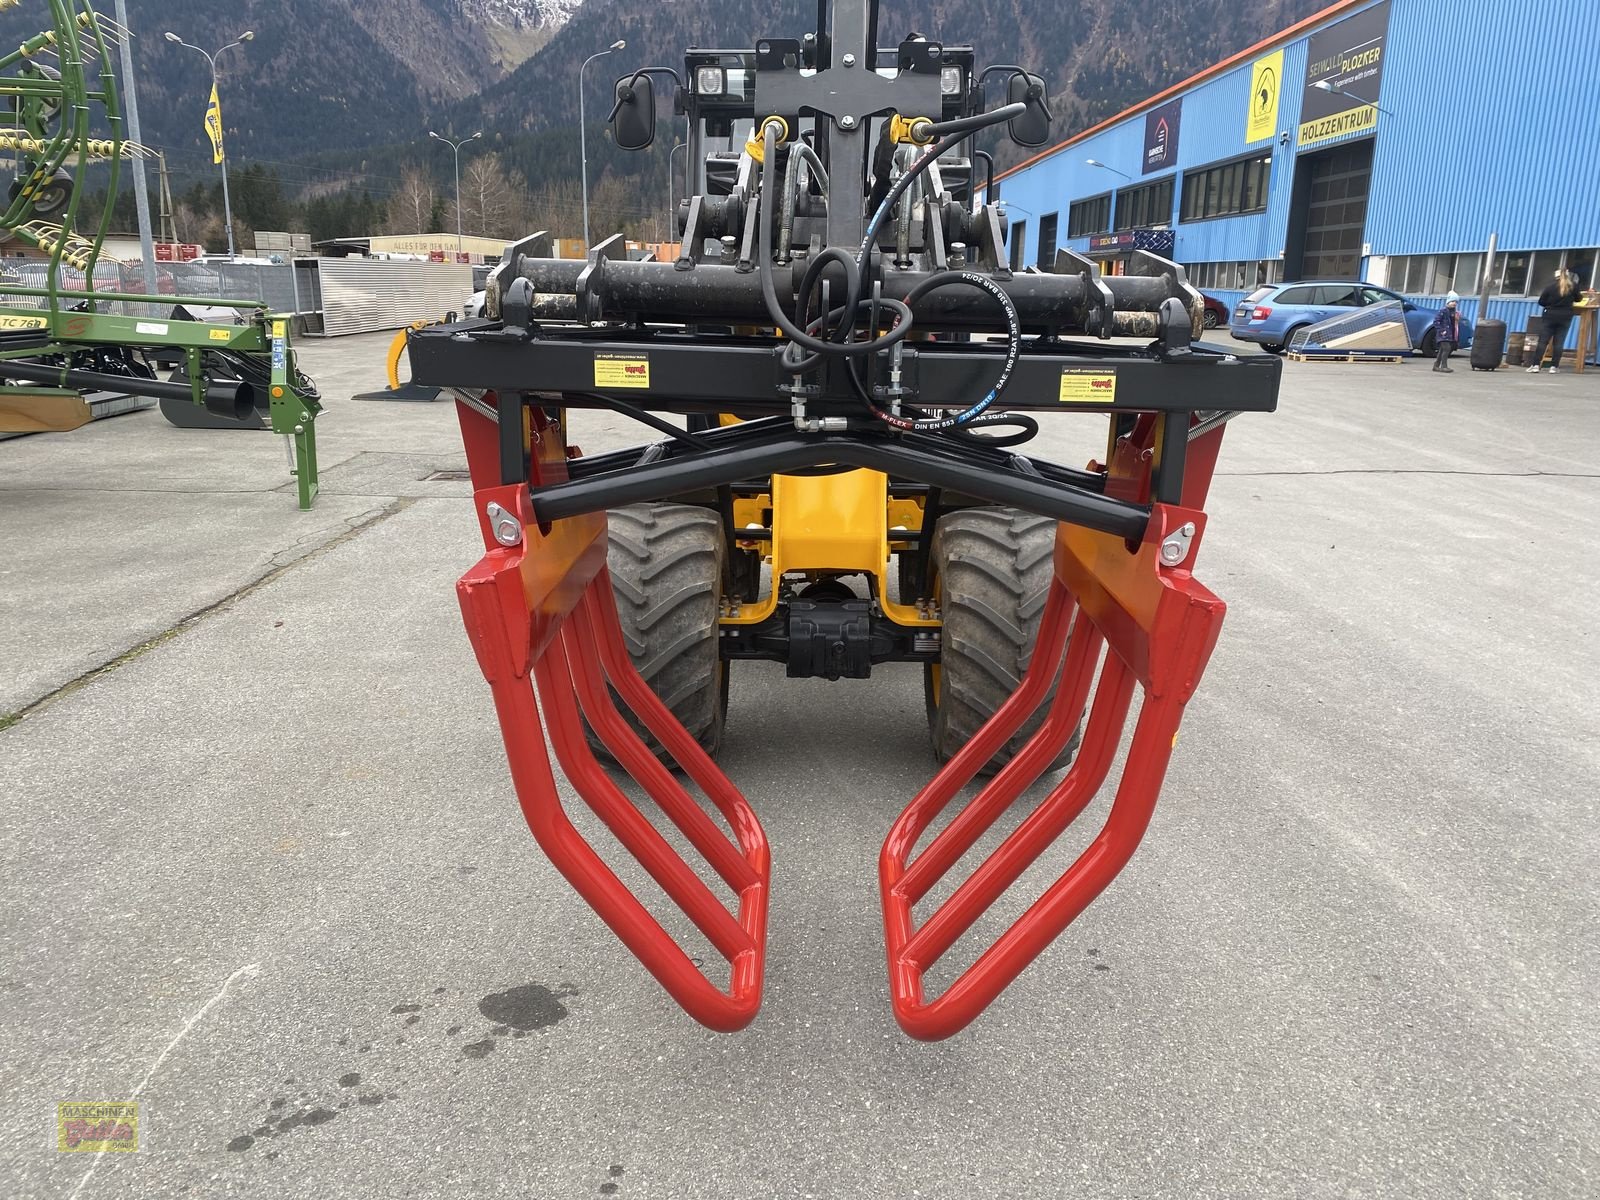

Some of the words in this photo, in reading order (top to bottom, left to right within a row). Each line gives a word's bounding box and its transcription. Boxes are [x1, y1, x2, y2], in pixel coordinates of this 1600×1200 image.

[1301, 107, 1374, 141] HOLZZENTRUM
[394, 242, 413, 250] ALLES
[962, 272, 984, 284] 2Q/24
[983, 280, 999, 293] BAR
[997, 292, 1008, 305] 330
[1005, 306, 1014, 319] WP
[2, 318, 17, 327] TC
[1009, 336, 1018, 358] R2AT
[1005, 359, 1014, 372] 100
[996, 373, 1009, 390] SAE
[976, 394, 993, 411] DN10
[881, 413, 907, 427] M-FLEX
[962, 410, 976, 420] 2SN
[941, 419, 955, 428] 853
